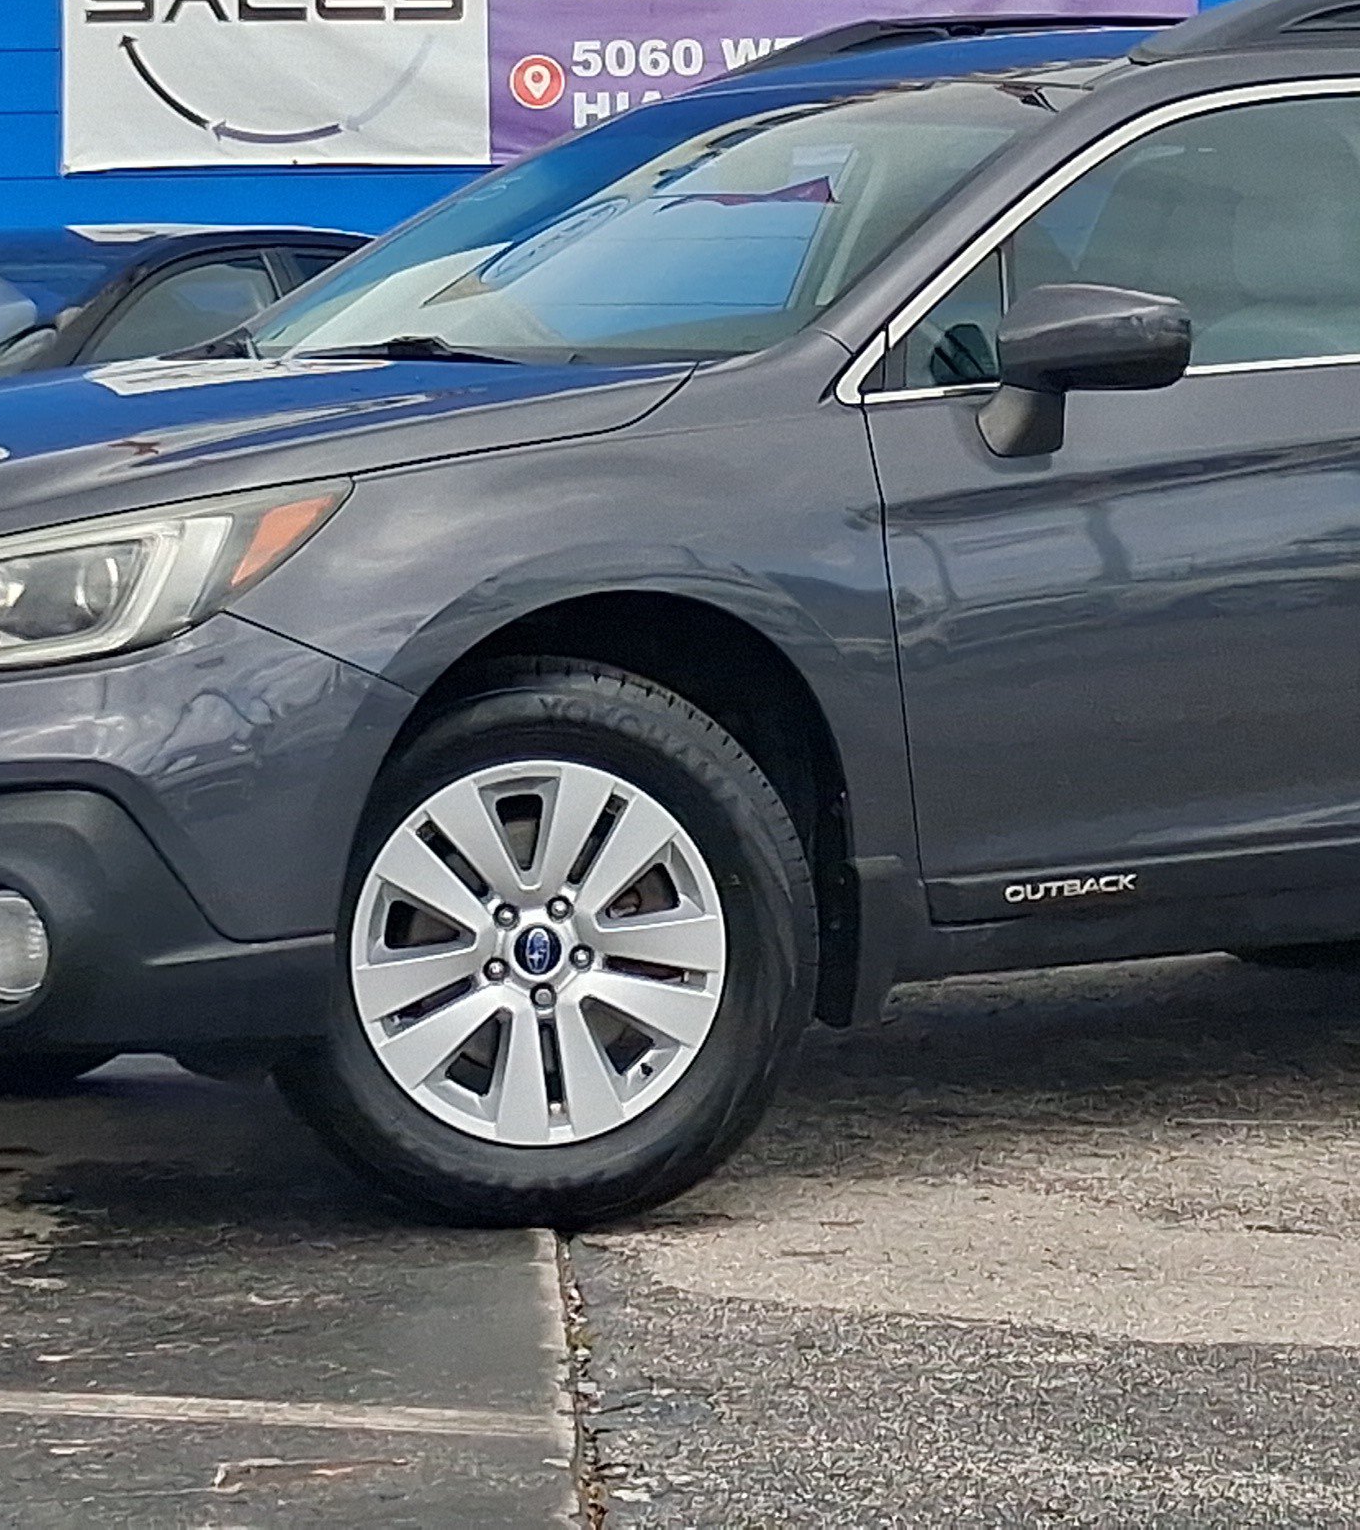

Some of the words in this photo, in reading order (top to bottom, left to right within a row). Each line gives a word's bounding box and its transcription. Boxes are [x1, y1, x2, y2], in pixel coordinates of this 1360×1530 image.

[570, 38, 704, 77] 5060
[721, 37, 805, 71] W
[1004, 873, 1137, 903] OUTBACK
